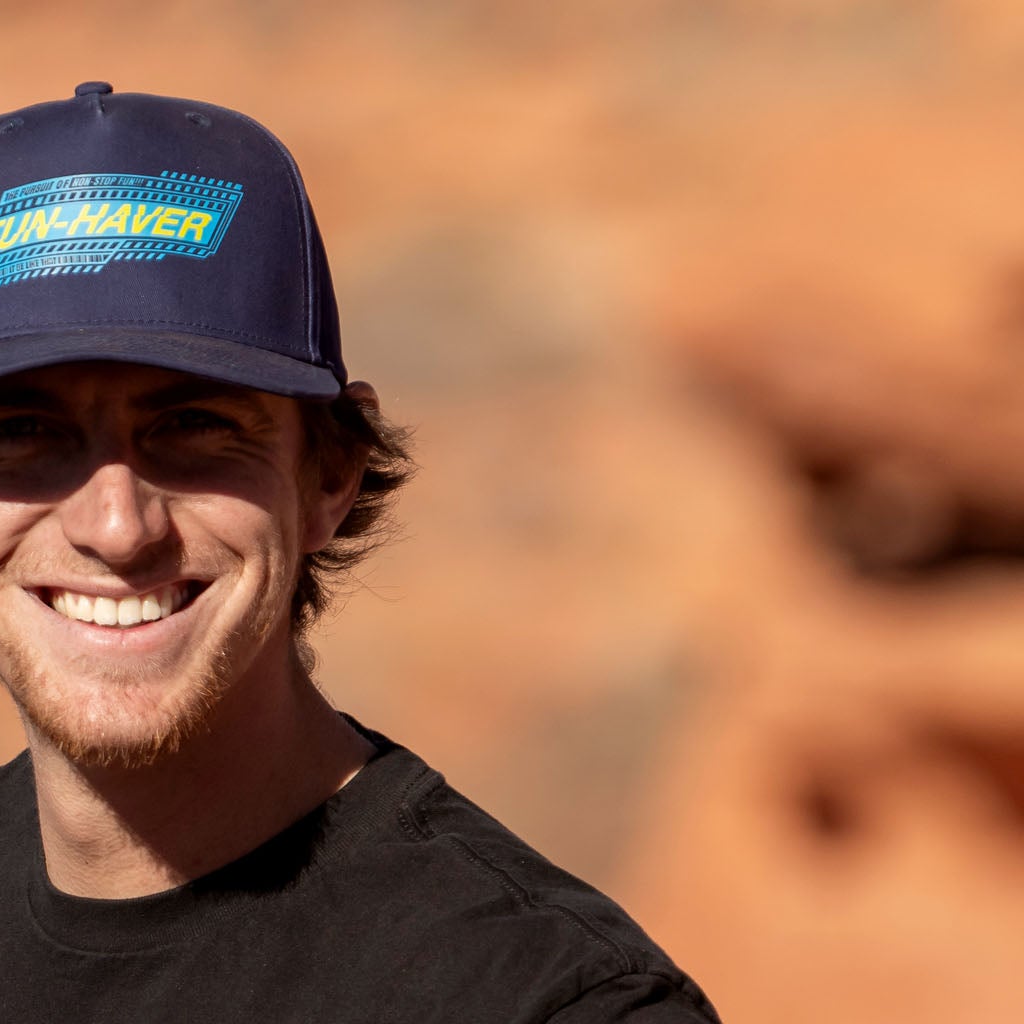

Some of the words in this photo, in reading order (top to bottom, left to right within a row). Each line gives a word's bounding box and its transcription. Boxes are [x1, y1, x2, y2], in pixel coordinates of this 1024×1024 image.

[4, 190, 20, 202] THE
[19, 181, 55, 197] PURSUIT
[56, 179, 70, 189] OF
[72, 176, 117, 187] NON-STOP
